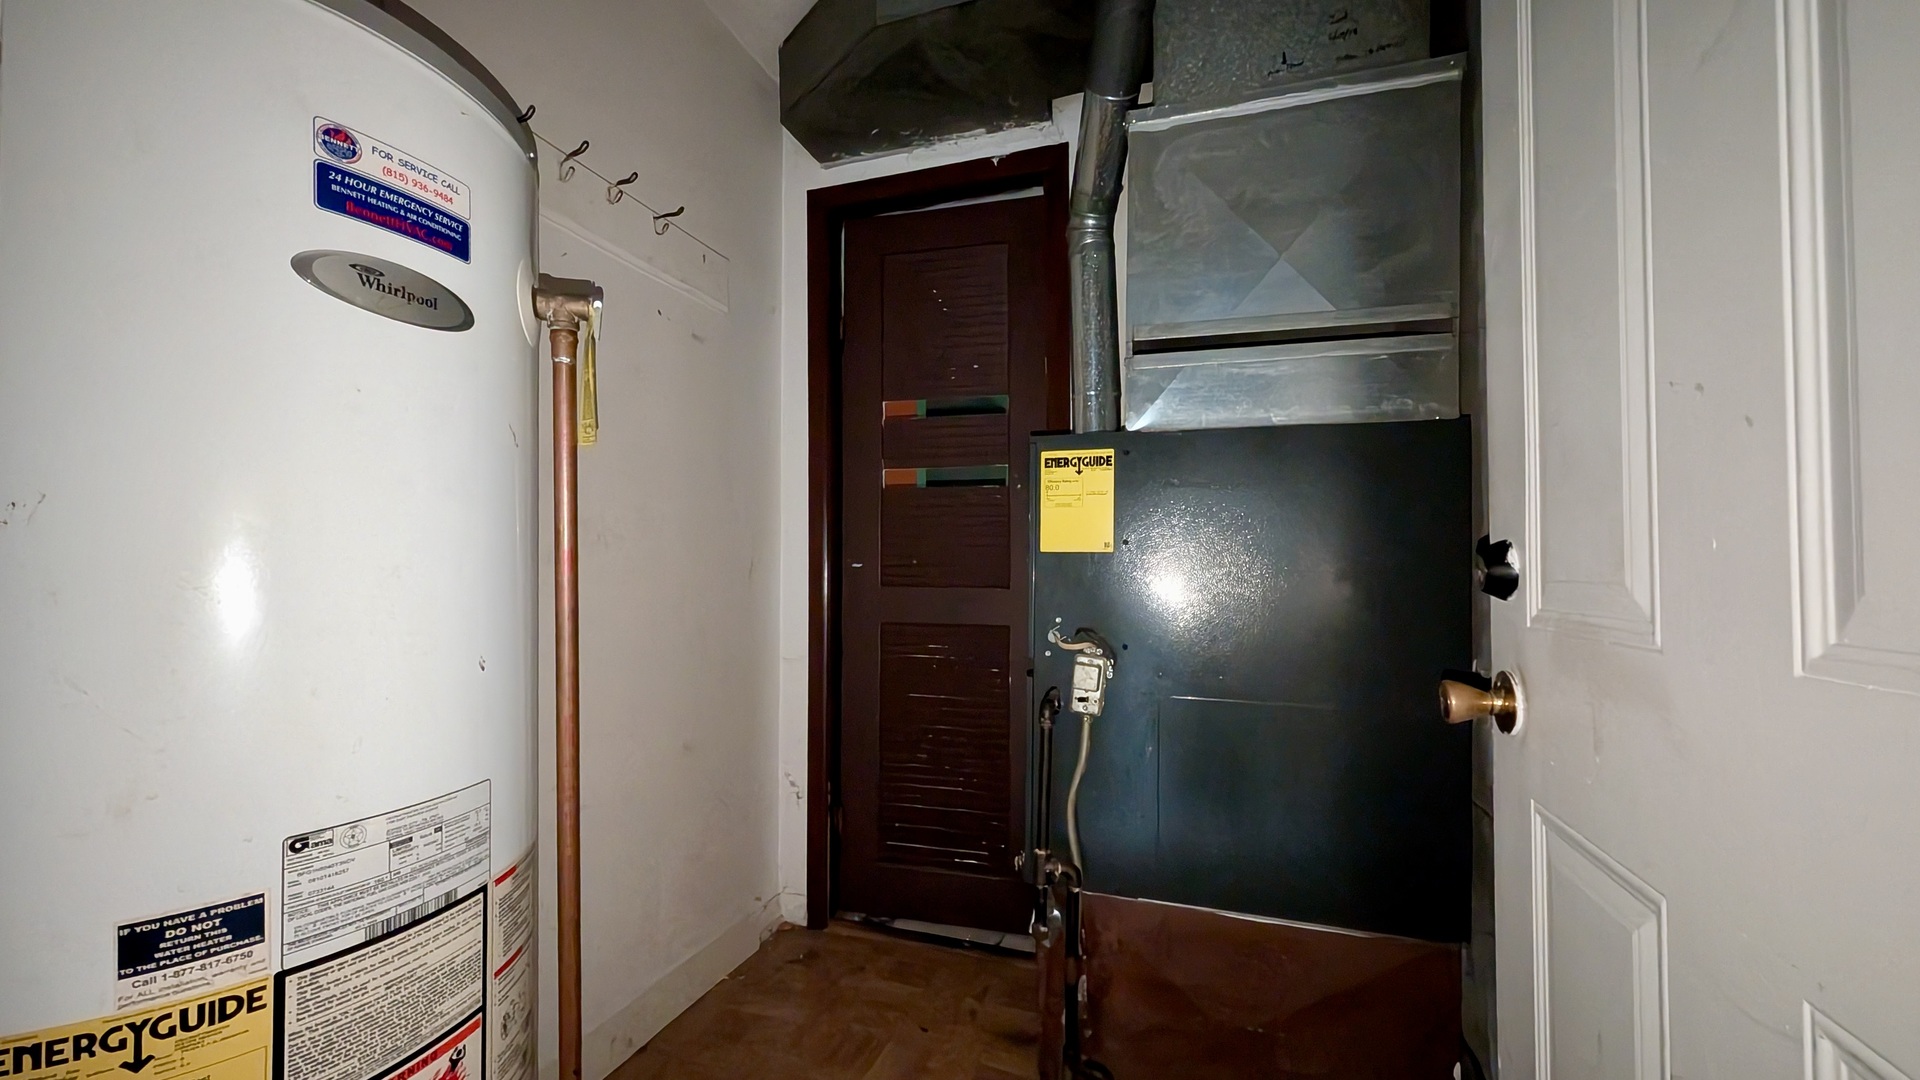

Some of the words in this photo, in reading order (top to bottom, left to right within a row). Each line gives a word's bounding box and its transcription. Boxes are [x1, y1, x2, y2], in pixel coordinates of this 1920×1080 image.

[372, 146, 393, 163] FOR
[398, 158, 438, 183] SERVICE
[441, 179, 461, 195] CALL
[382, 166, 409, 185] (815)
[412, 178, 453, 205] 936-9484
[328, 171, 342, 182] 24
[345, 176, 377, 194] HOUR
[379, 189, 433, 219] EMERGENCY
[434, 212, 464, 233] SERVICE
[331, 184, 365, 201] BENNETT
[368, 197, 399, 215] HEATING
[400, 208, 405, 216] &
[418, 215, 462, 241] CONDITIONING
[357, 272, 438, 311] Whirlpool
[1044, 455, 1113, 473] ENERGYGUIDE
[119, 928, 132, 936] IF
[134, 922, 160, 933] YOU
[163, 914, 196, 927] HAVE
[210, 897, 264, 917] PROBLEM
[164, 927, 188, 939] DO
[191, 918, 223, 932] NOT
[153, 946, 191, 959] WATER
[193, 934, 233, 950] HEATER
[158, 934, 202, 949] RETURN
[203, 927, 228, 938] THIS
[119, 967, 134, 976] TO
[136, 960, 158, 972] THE
[159, 953, 193, 967] PLACE
[194, 949, 208, 958] OF
[131, 975, 158, 989] Call
[161, 950, 254, 981] 1-877-817-6750
[117, 995, 134, 1003] For
[391, 1051, 438, 1080] RNING
